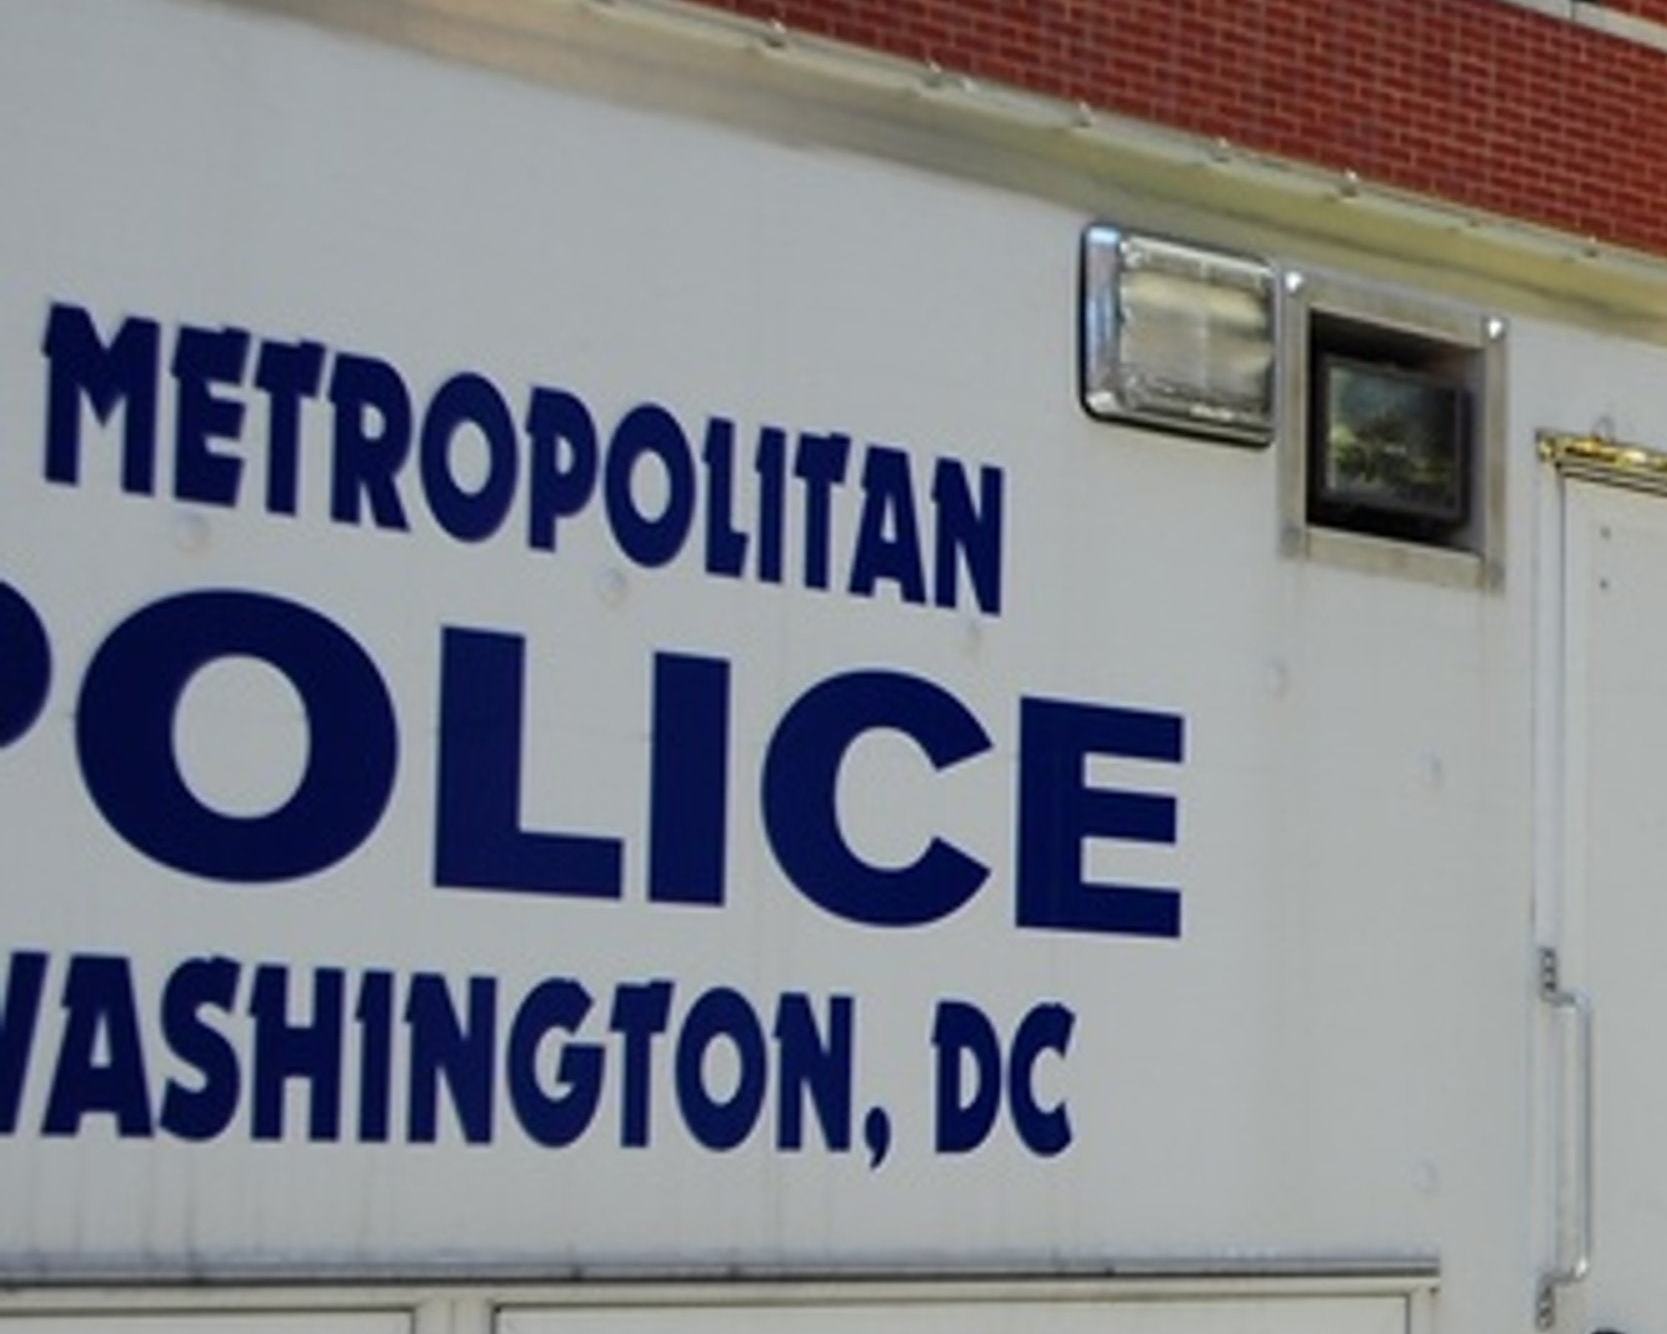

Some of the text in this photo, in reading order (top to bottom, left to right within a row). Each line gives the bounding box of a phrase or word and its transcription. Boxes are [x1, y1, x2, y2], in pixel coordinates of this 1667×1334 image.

[41, 302, 1004, 617] METROPOLITAN
[0, 578, 1186, 939] OLICE
[931, 999, 1076, 1158] DC
